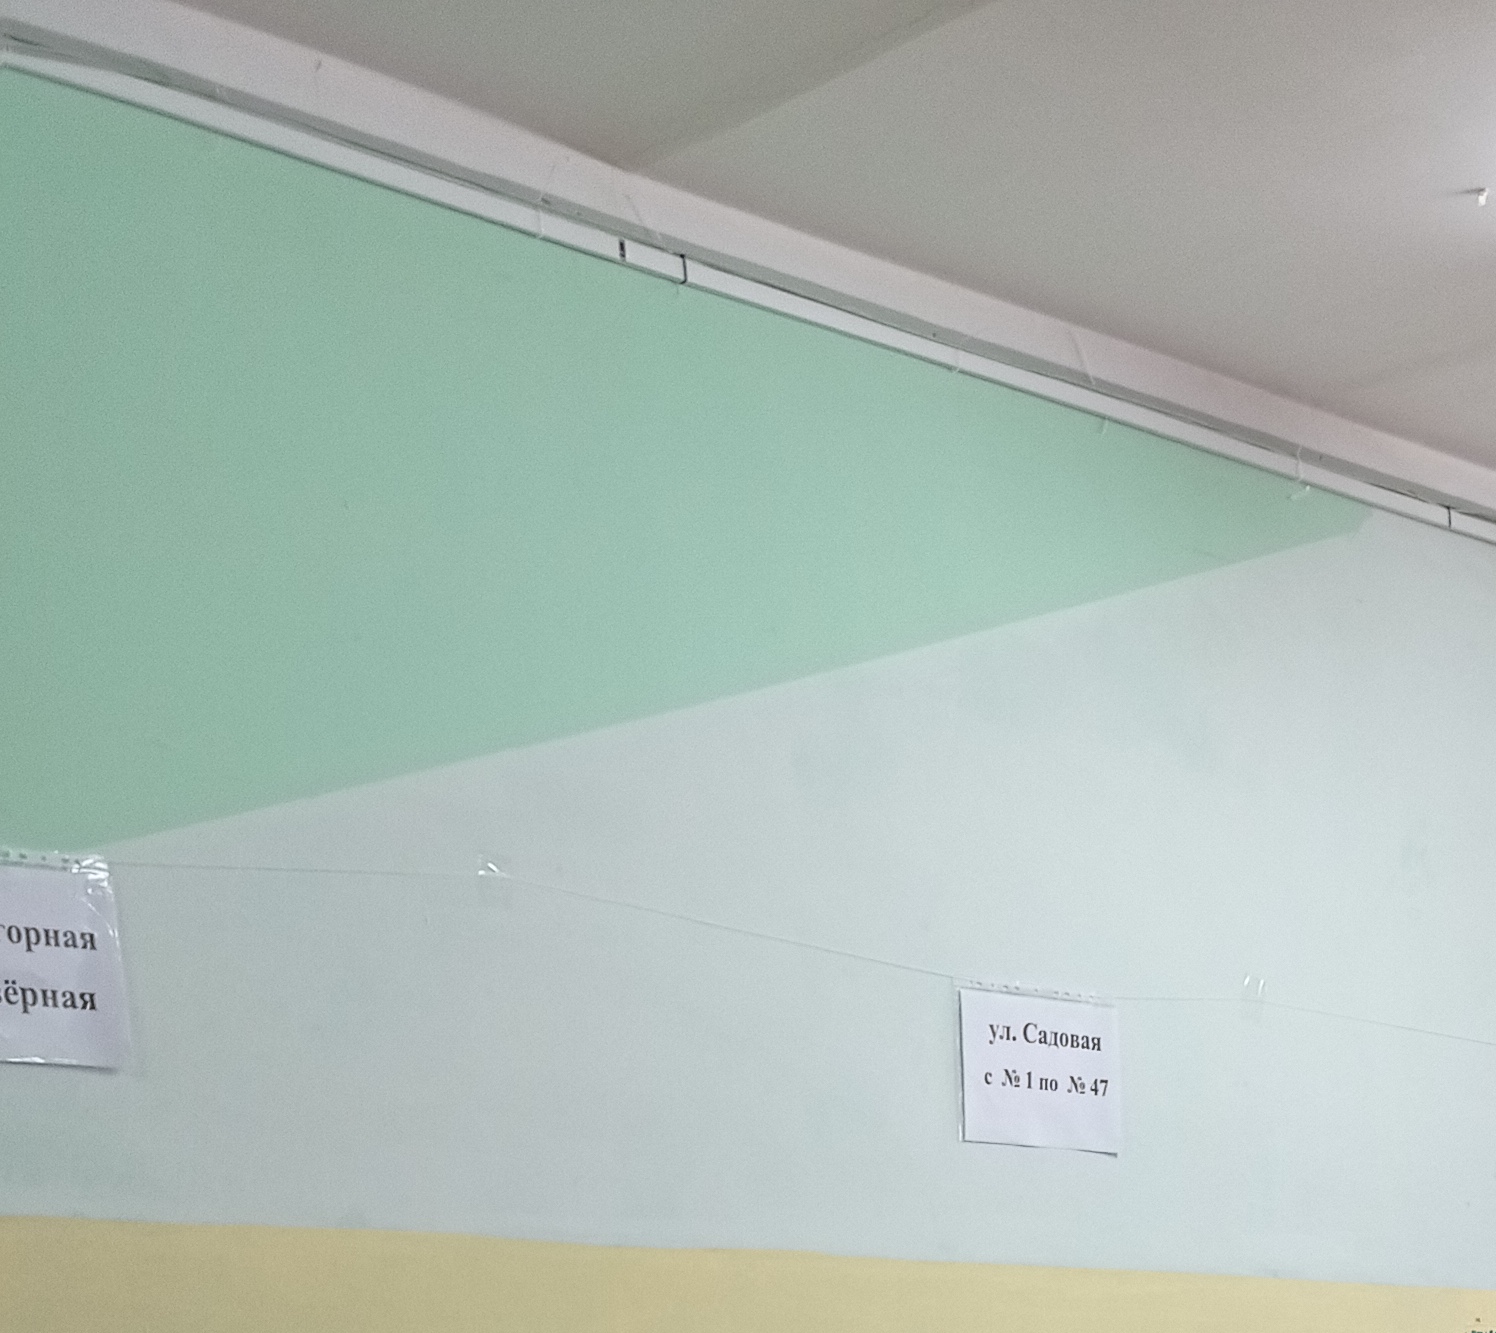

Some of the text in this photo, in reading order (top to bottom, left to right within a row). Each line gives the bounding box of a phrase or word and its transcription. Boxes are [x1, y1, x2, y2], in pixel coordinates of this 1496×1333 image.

[0, 979, 98, 1014] ёрная
[988, 1022, 1102, 1052] ул. Садовая
[984, 1071, 993, 1085] с
[1026, 1071, 1033, 1089] 1
[1039, 1076, 1058, 1092] по
[1089, 1079, 1109, 1097] 47
